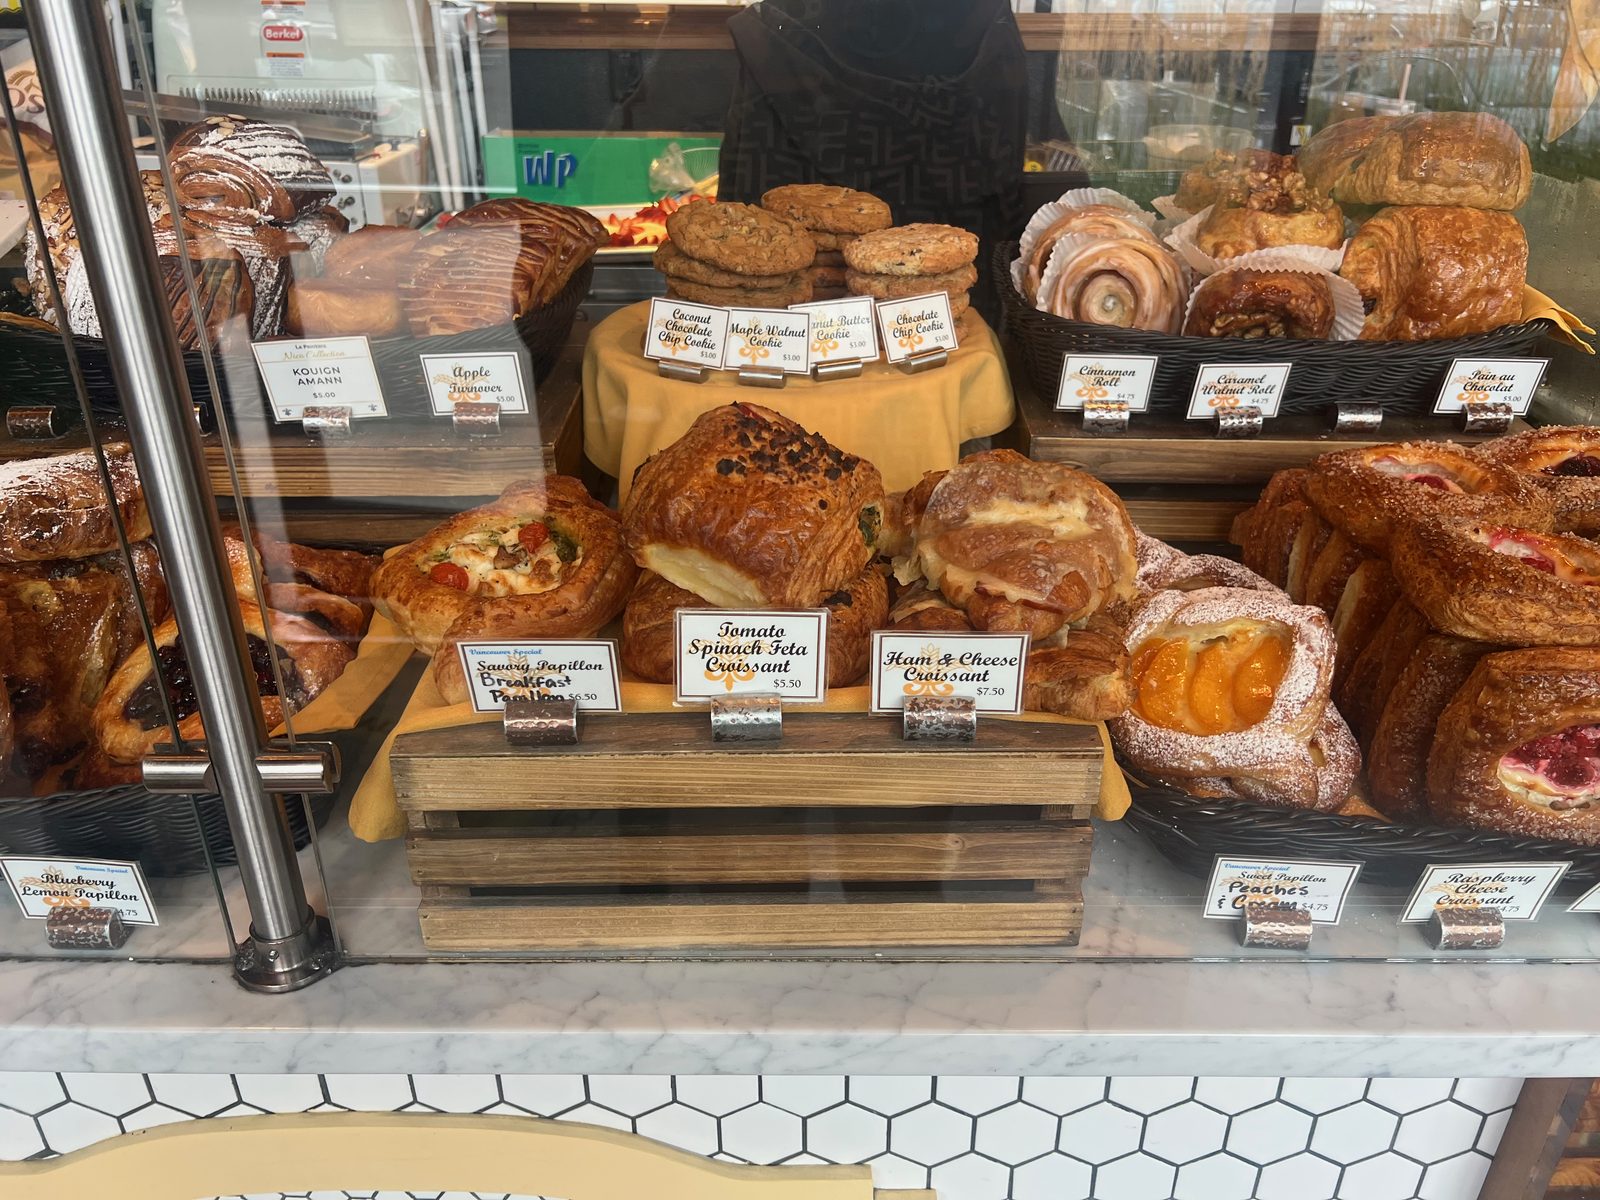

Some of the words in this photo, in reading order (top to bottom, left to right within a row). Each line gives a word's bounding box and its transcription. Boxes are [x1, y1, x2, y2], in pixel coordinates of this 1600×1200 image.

[265, 28, 300, 39] Berkel
[672, 308, 712, 325] Coconut
[837, 315, 871, 326] Butter
[896, 310, 939, 325] Chocolate
[665, 319, 713, 337] Chocolate
[729, 323, 763, 337] Maple
[766, 325, 807, 338] Walnut
[893, 327, 913, 339] Chip
[915, 320, 944, 334] Cookie
[658, 331, 680, 345] Chip
[684, 335, 716, 350] Cookie
[816, 328, 850, 341] Cookie
[750, 336, 783, 348] Cookie
[850, 341, 866, 349] $3.00
[700, 351, 717, 359] $3.00
[292, 366, 341, 376] KOUIGN
[453, 366, 491, 380] Apple
[1079, 365, 1136, 377] Cinnamon
[1468, 369, 1497, 381] Pain
[297, 376, 343, 386] AMANN
[1091, 376, 1120, 387] Roll
[1217, 374, 1267, 384] Caramel
[448, 382, 503, 394] Turnover
[1201, 385, 1246, 395] Walnut
[1247, 384, 1277, 395] Roll
[1463, 381, 1514, 392] Chocolat
[717, 621, 786, 638] Tomato
[688, 639, 764, 659] Spinach
[768, 639, 809, 656] Feta
[705, 656, 791, 673] Croissant
[883, 651, 931, 666] Ham
[937, 652, 955, 668] &
[958, 652, 1018, 667] Cheese
[476, 660, 531, 673] Savory
[536, 660, 604, 674] Papillon
[903, 666, 991, 682] Croissant
[773, 679, 802, 689] $5.50
[568, 693, 598, 701] $6.50
[976, 687, 1005, 696] $7.50
[1262, 864, 1291, 872] Special
[40, 873, 117, 890] Blueberry
[1238, 871, 1273, 880] Sweet
[1275, 872, 1327, 883] Papillon
[1443, 872, 1536, 886] Raspberry
[21, 886, 70, 897] Lemon
[74, 887, 140, 902] Papillon
[1228, 881, 1309, 896] Peaches
[1454, 883, 1509, 894] Cheese
[1436, 894, 1515, 905] Croissant
[117, 908, 138, 917] 4.75
